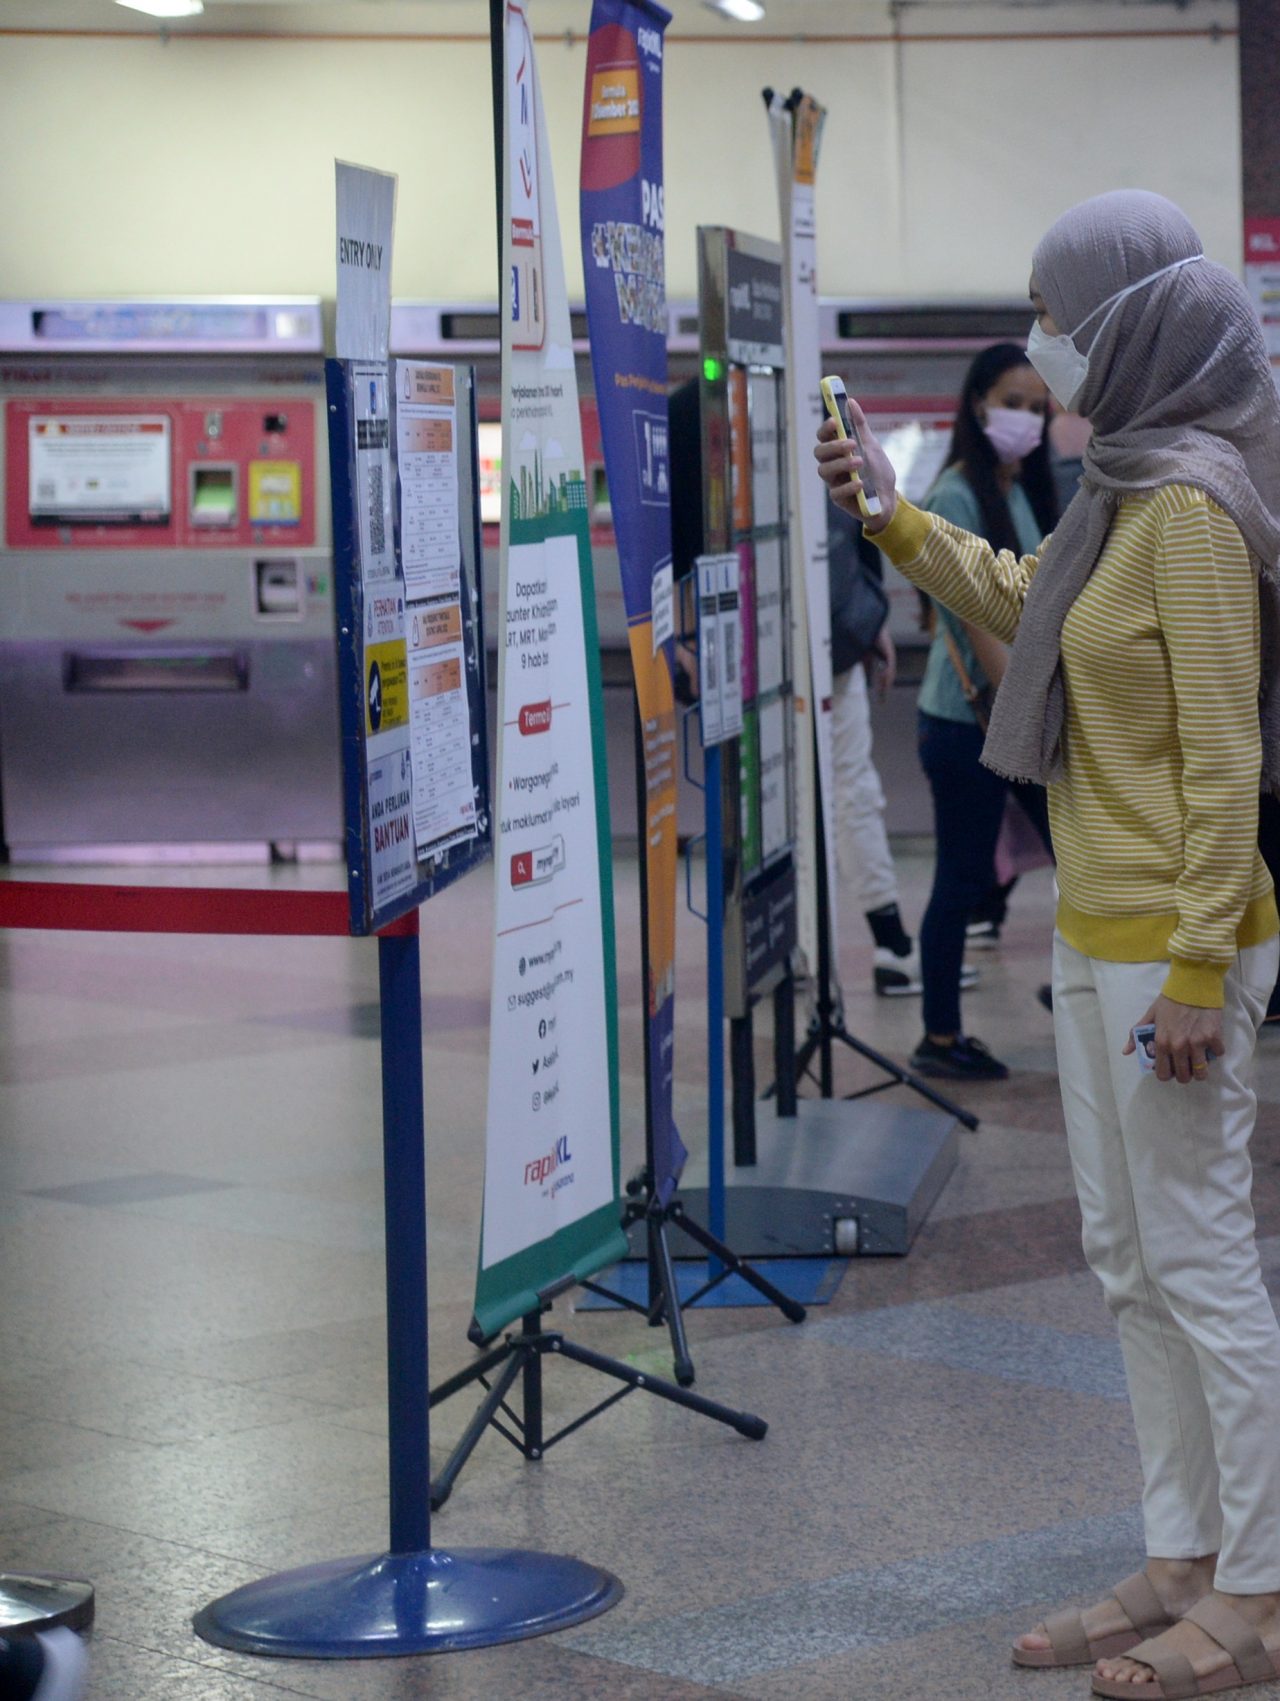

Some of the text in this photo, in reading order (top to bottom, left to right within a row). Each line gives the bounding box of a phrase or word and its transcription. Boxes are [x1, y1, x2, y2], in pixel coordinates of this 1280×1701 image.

[340, 237, 383, 271] ENTRY ONLY
[374, 813, 410, 853] BANTUAN
